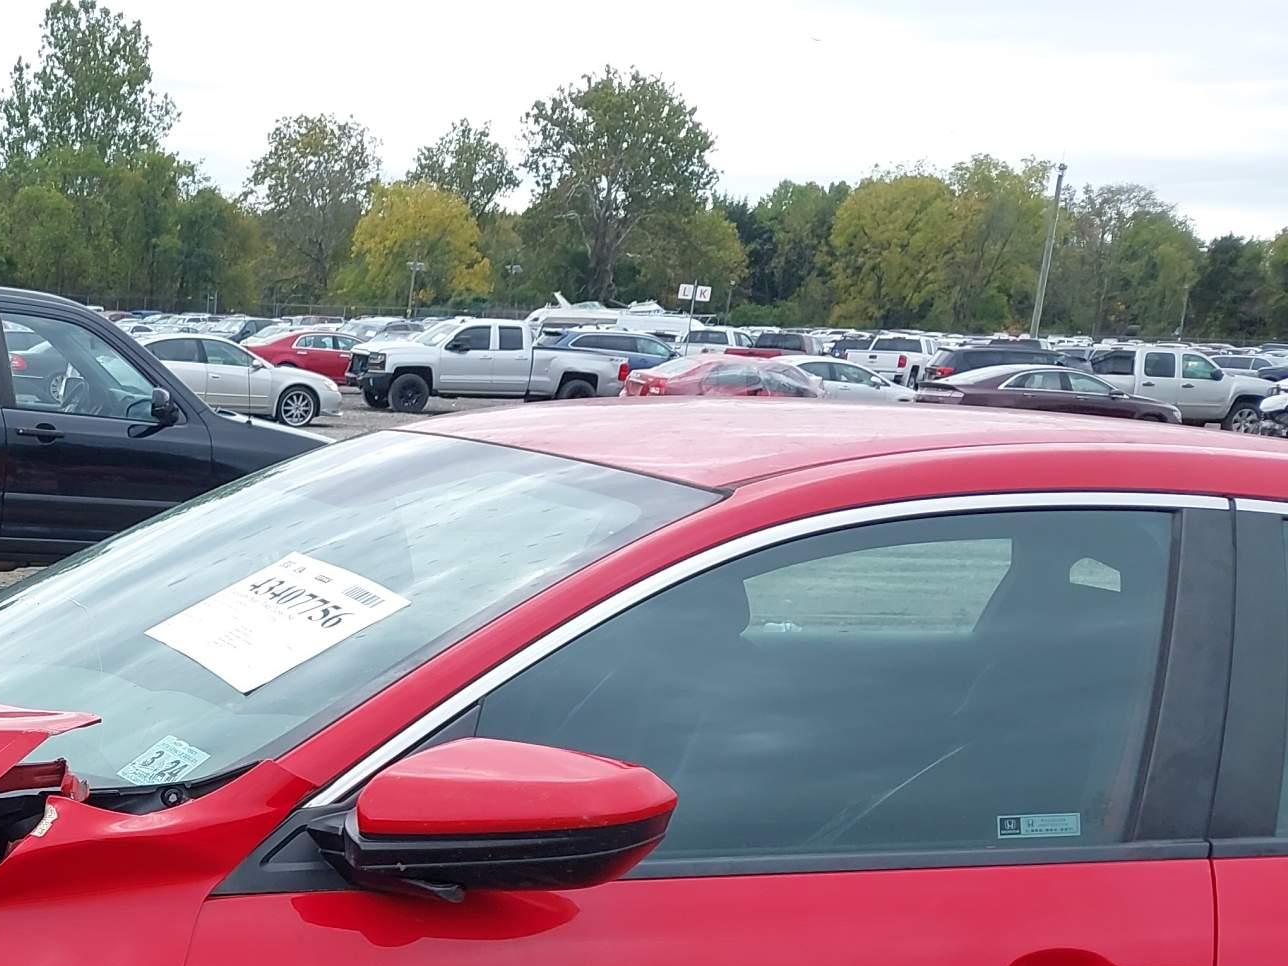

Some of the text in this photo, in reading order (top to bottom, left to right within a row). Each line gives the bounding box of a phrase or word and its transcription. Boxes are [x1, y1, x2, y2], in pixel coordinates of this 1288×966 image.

[682, 287, 689, 297] L
[699, 288, 708, 299] K
[249, 577, 355, 628] 43407756
